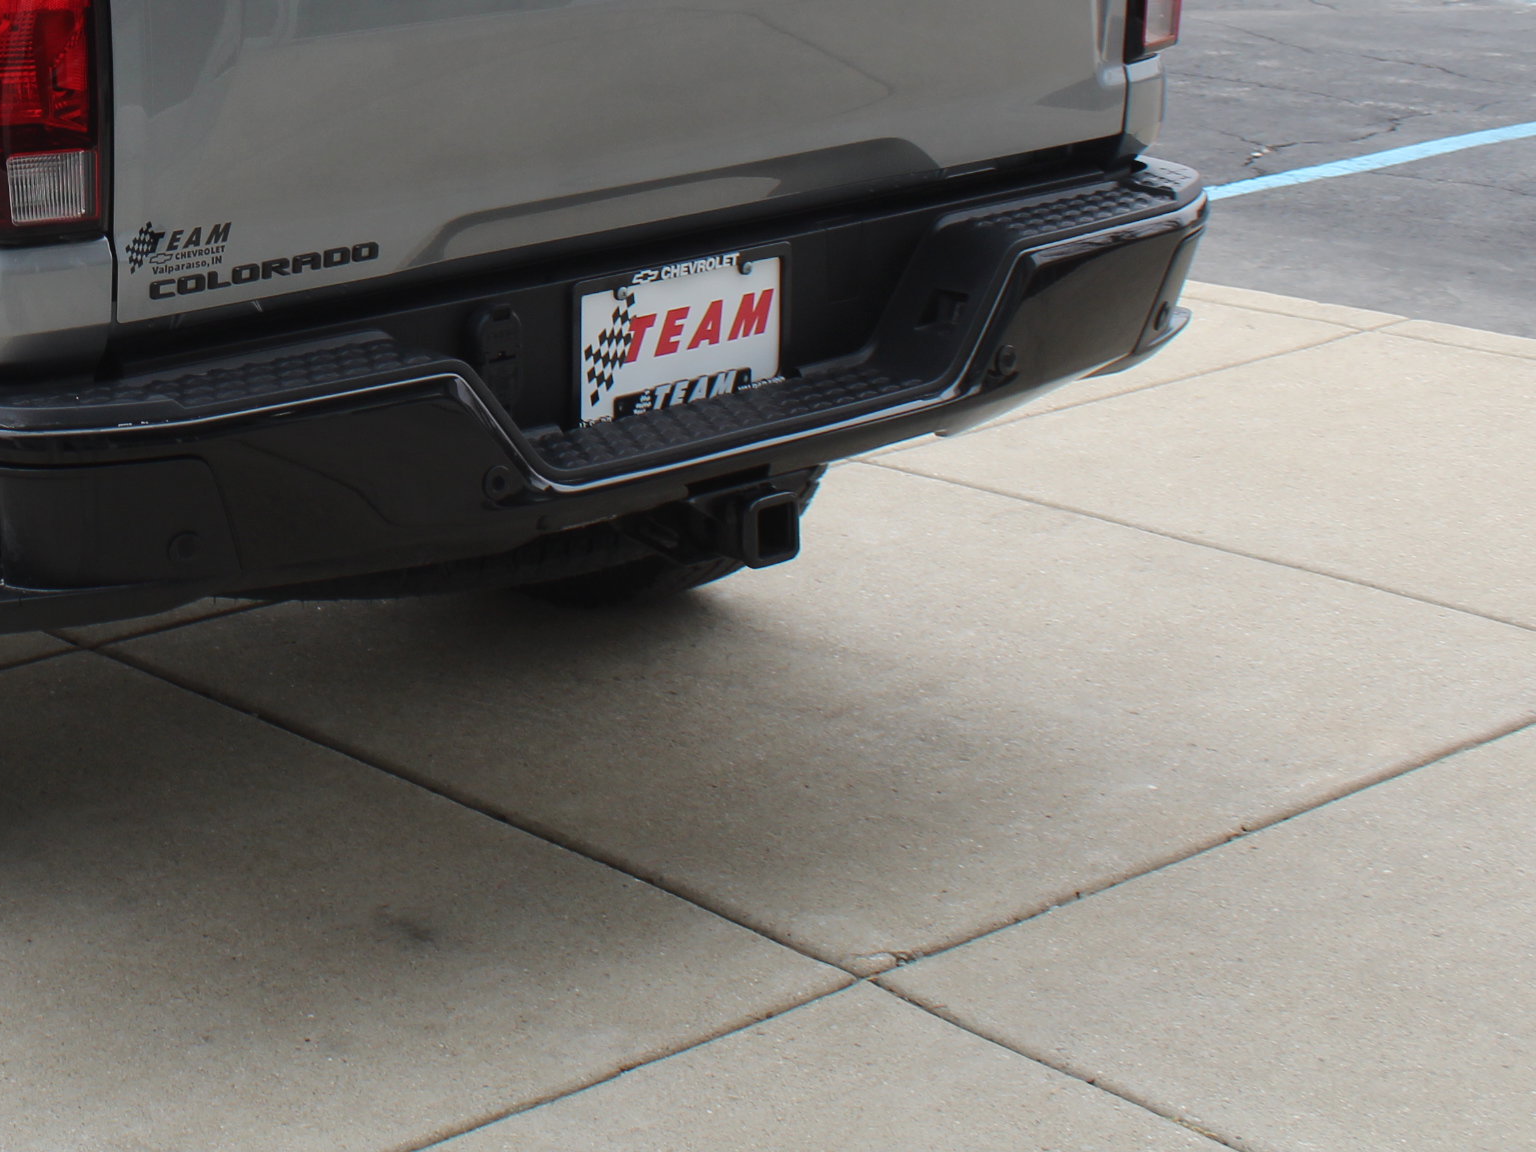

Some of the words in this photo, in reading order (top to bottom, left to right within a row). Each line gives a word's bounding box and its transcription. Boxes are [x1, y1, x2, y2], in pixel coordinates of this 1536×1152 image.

[150, 222, 232, 253] TEAM
[175, 245, 226, 260] CHEVROLET
[149, 241, 380, 301] COLORADO
[211, 255, 222, 265] IN
[660, 252, 741, 280] CHEVROLET
[624, 288, 775, 364] TEAM
[653, 369, 738, 410] TEAM
